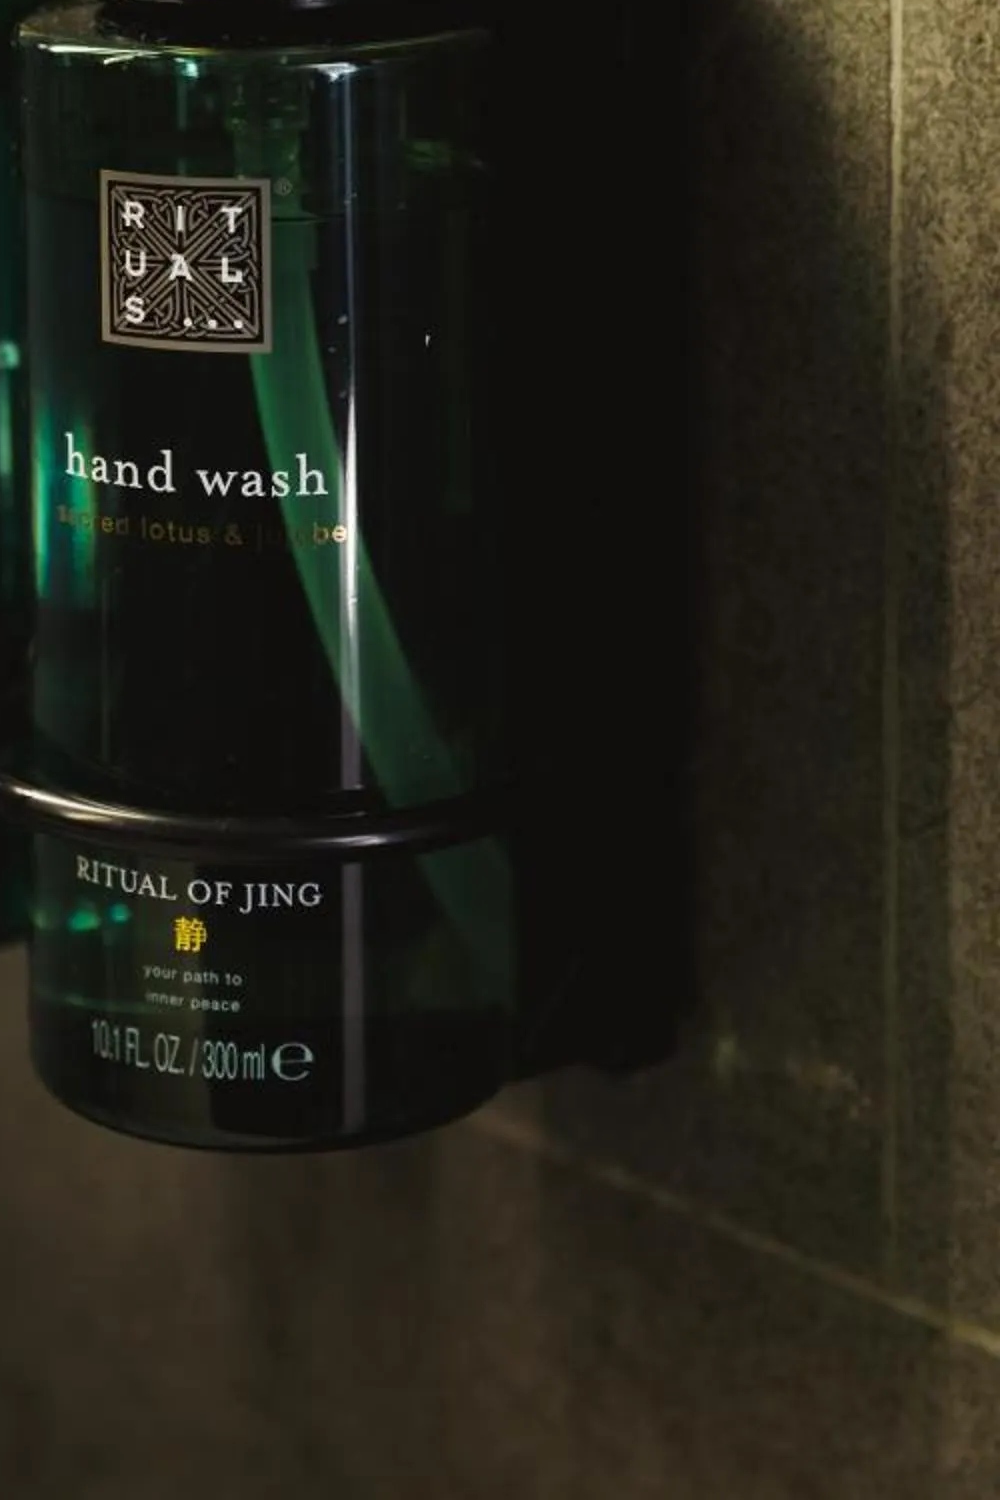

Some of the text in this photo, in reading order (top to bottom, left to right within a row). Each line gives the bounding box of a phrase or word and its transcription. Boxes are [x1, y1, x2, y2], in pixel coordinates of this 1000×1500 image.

[65, 432, 329, 498] hand wash
[141, 514, 212, 546] lotus
[224, 523, 244, 546] &
[76, 855, 323, 914] RITUAL OF JING
[143, 965, 243, 986] your path to
[190, 998, 241, 1012] peace
[202, 1040, 238, 1080] 300
